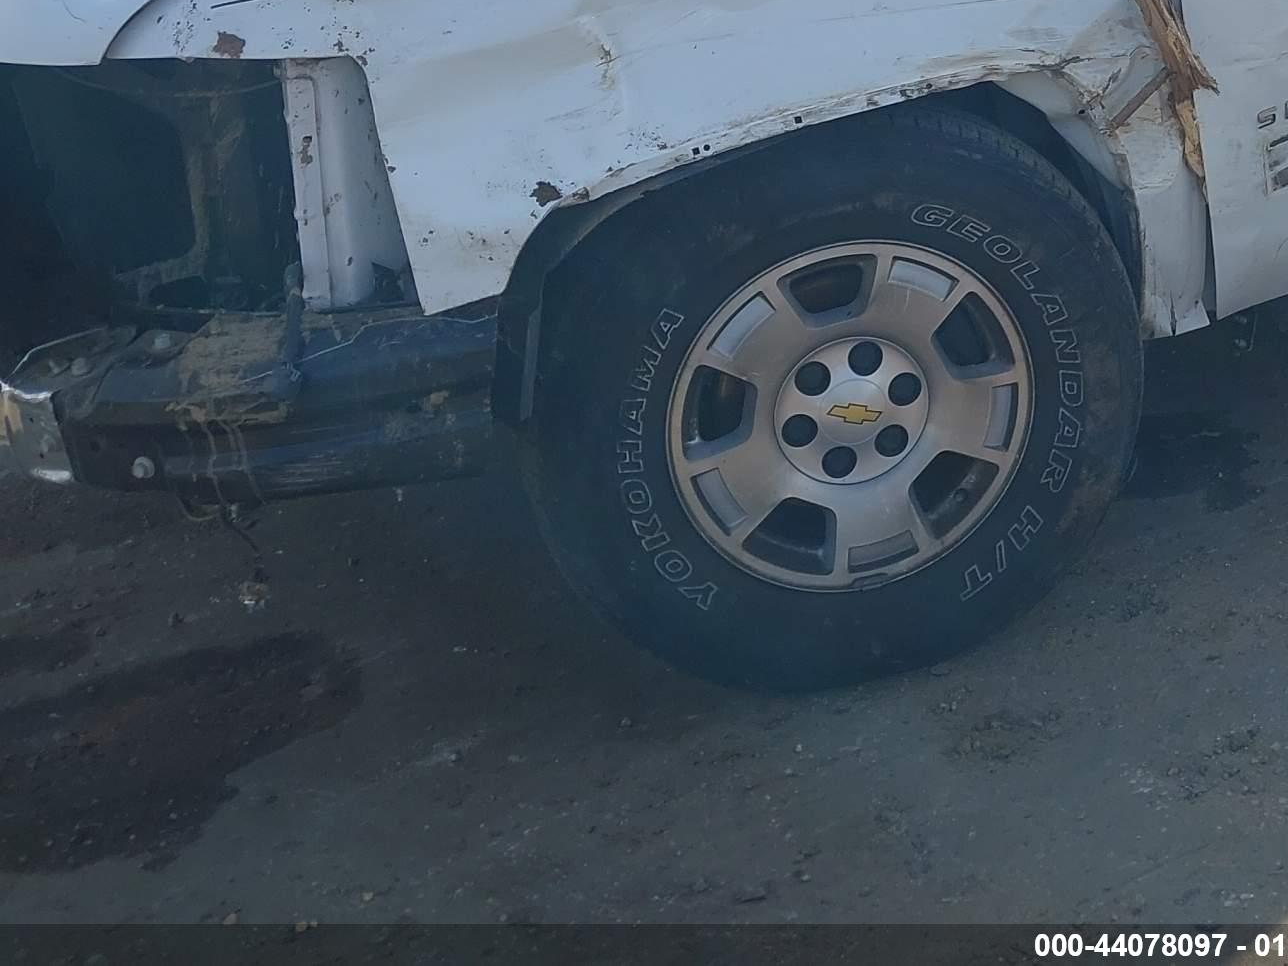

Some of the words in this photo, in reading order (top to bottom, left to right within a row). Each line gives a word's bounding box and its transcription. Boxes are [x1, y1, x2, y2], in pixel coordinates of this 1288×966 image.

[617, 308, 721, 610] YOKOHAMA
[911, 203, 1084, 493] GEOLANDAR
[959, 505, 1045, 601] H/T
